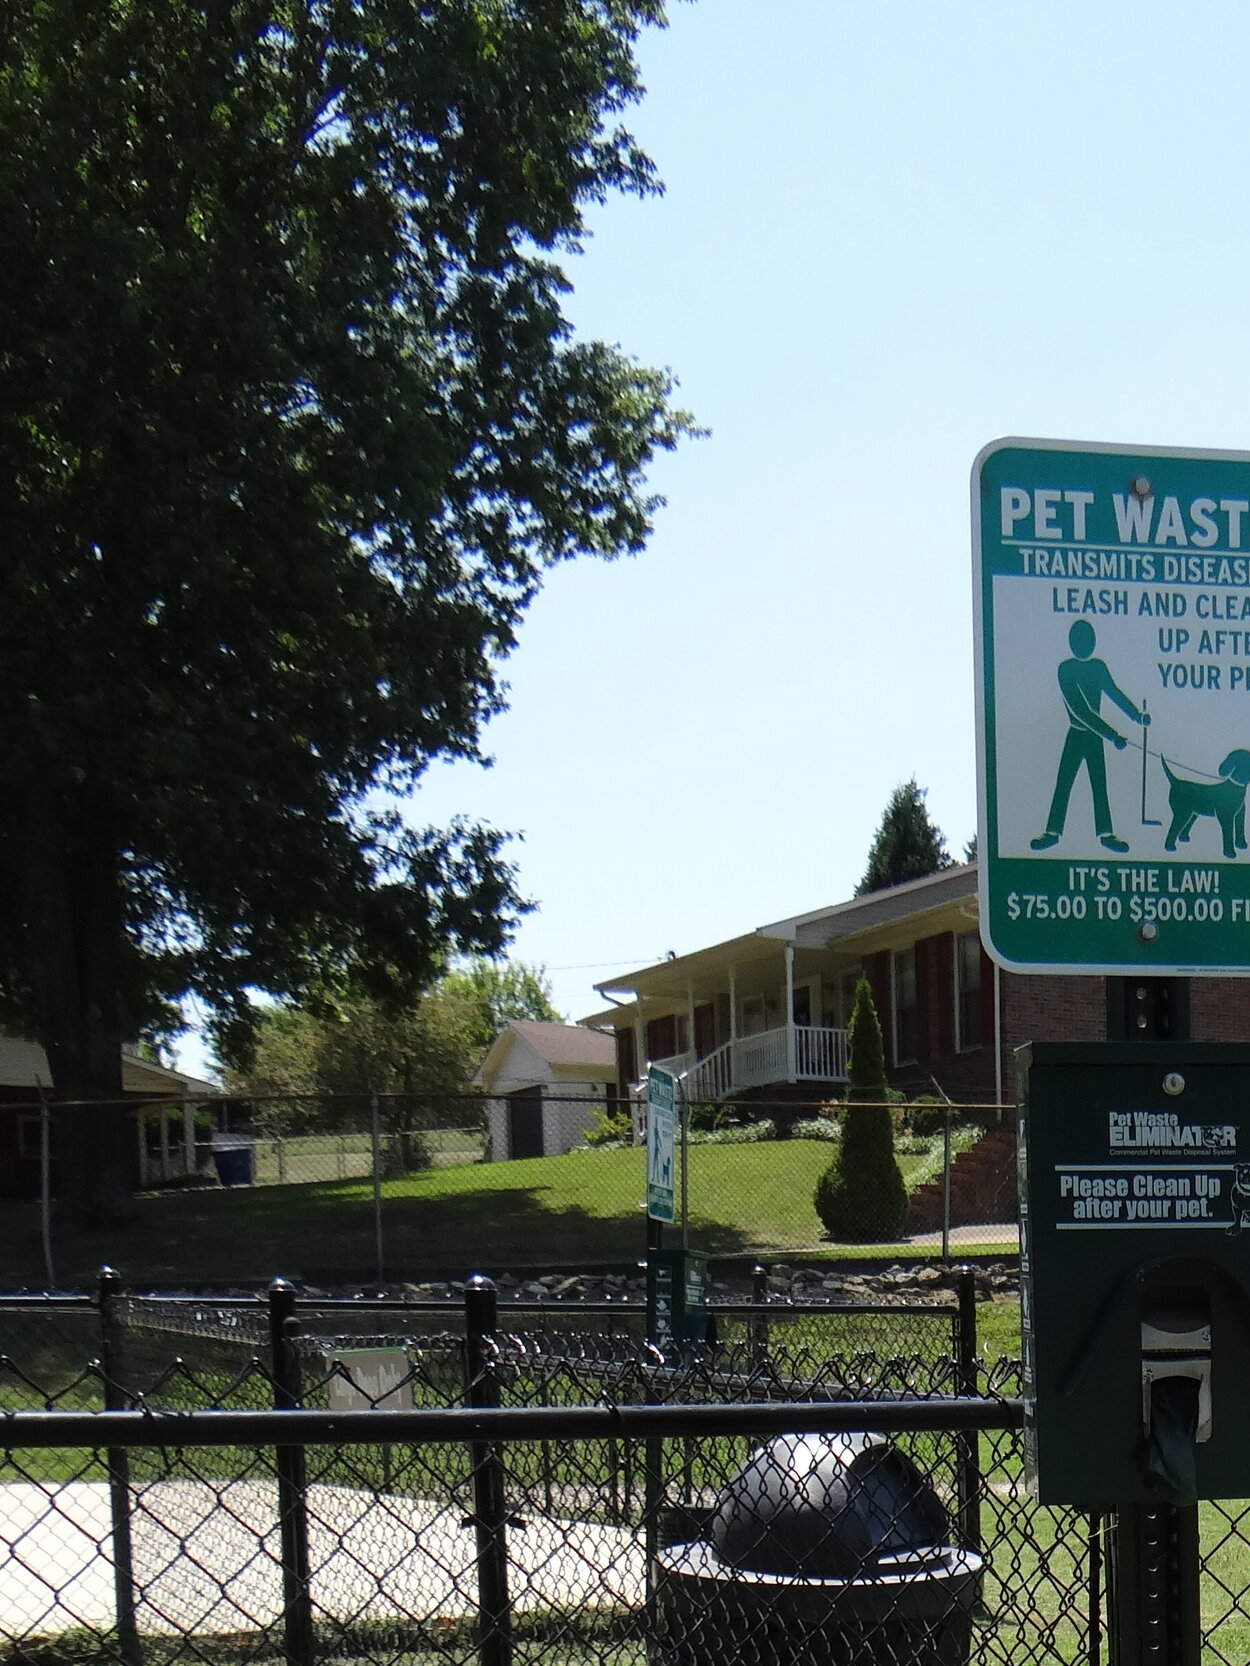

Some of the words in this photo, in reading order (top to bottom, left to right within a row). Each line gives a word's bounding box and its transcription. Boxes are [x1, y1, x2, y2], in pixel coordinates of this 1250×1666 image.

[1000, 487, 1094, 541] PET
[1019, 549, 1154, 580] TRANSMITS
[1052, 587, 1129, 615] LEASH
[1138, 591, 1187, 618] AND
[1158, 628, 1190, 653] UP
[1158, 663, 1221, 690] YOUR
[1069, 867, 1111, 892] IT'S
[1117, 869, 1160, 893] THE
[1168, 870, 1220, 894] LAW!
[1007, 892, 1087, 920] $75.00
[1095, 896, 1122, 920] TO
[1129, 896, 1224, 923] $500.00
[1109, 1111, 1132, 1126] Pet
[1133, 1111, 1179, 1126] Waste
[1212, 1149, 1237, 1157] System
[1060, 1175, 1127, 1197] Please
[1133, 1175, 1190, 1197] Clean
[1195, 1175, 1221, 1199] Up
[1073, 1198, 1122, 1219] after
[1126, 1200, 1173, 1220] your
[1176, 1198, 1214, 1220] pet.
